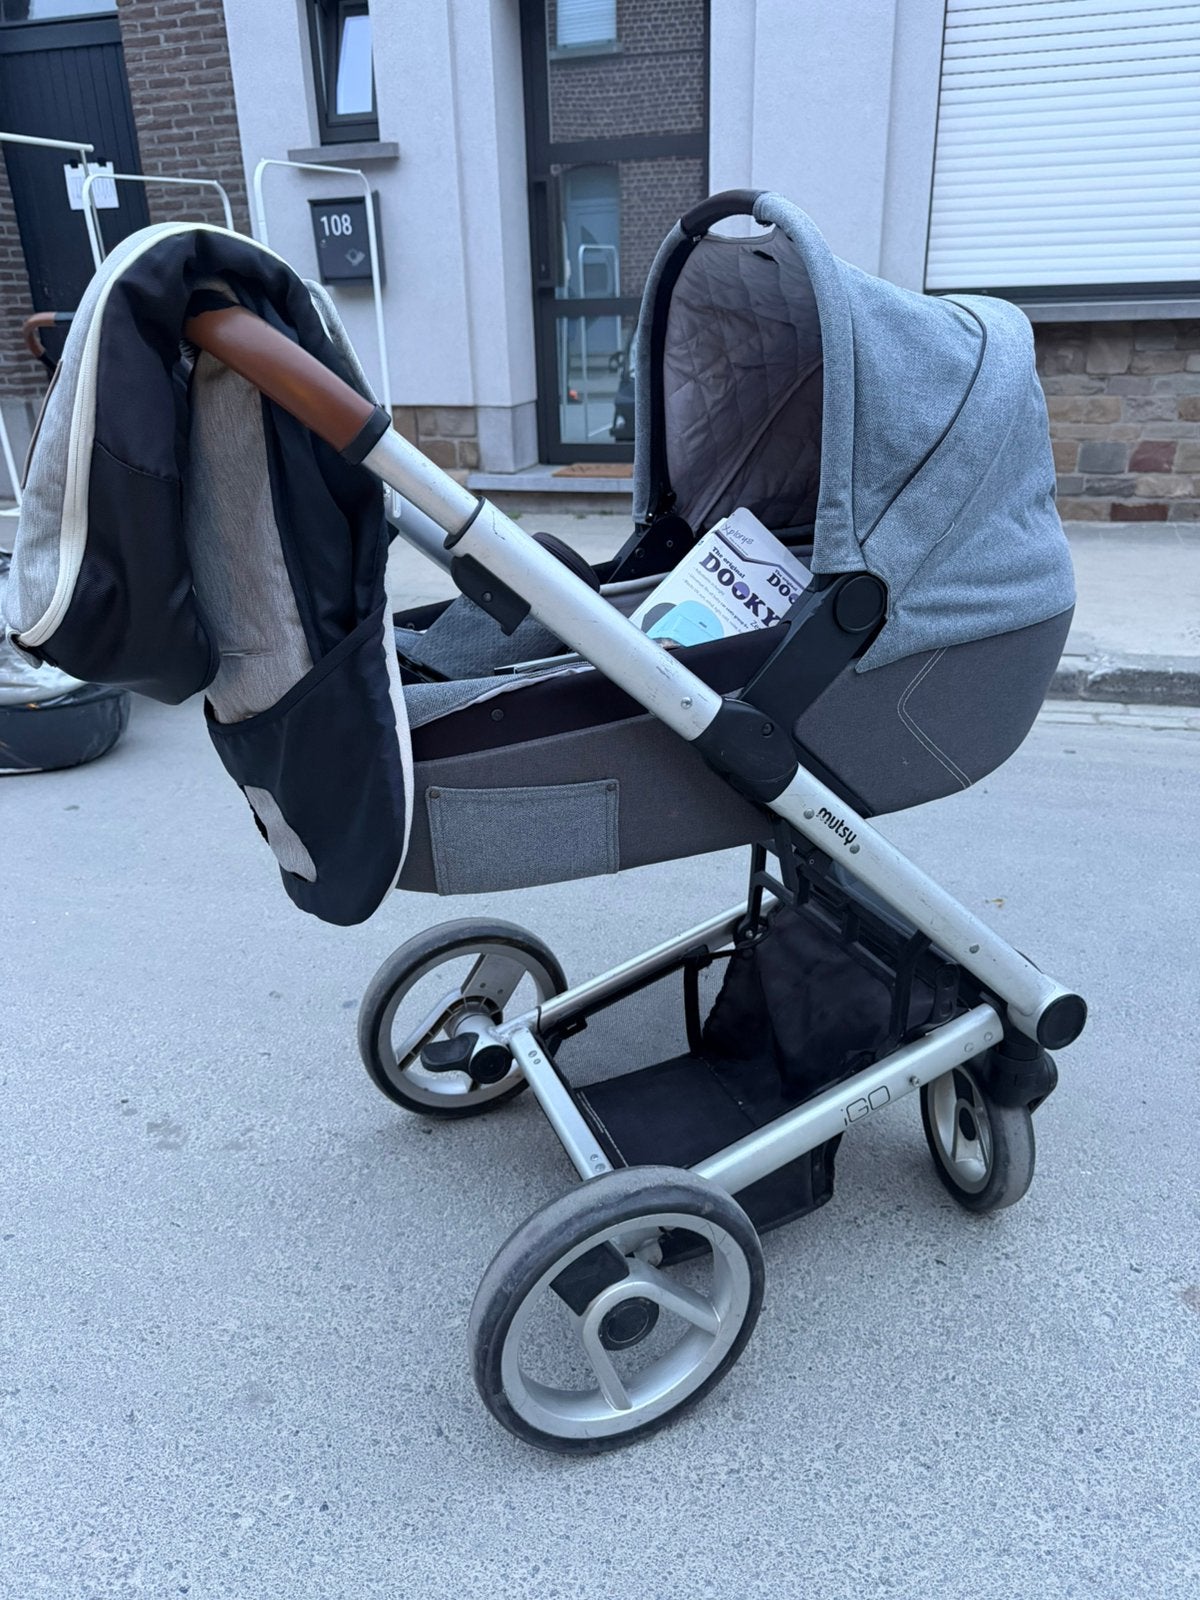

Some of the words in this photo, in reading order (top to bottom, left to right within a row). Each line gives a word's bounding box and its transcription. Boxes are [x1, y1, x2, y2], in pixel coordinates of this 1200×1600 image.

[320, 213, 353, 236] 108
[721, 523, 754, 545] Xplorys
[712, 546, 724, 558] The
[723, 557, 746, 579] original
[699, 551, 780, 627] DOOKY
[816, 807, 857, 846] mutsy
[840, 1085, 890, 1126] iGO
